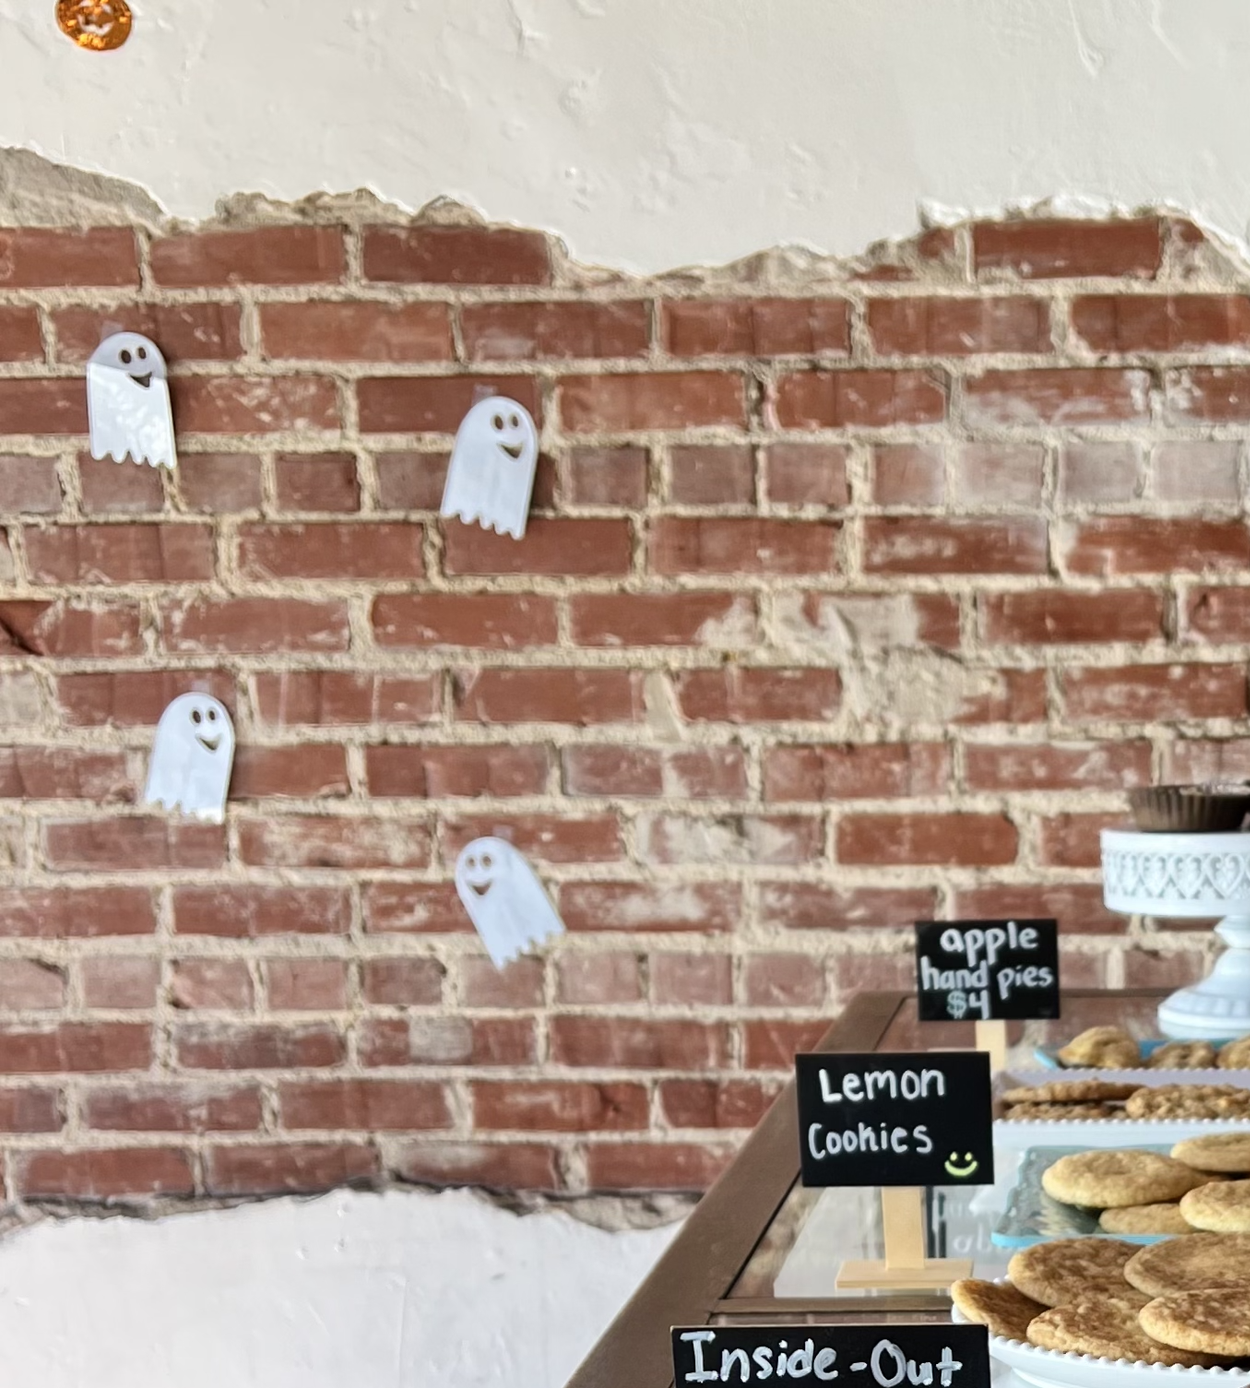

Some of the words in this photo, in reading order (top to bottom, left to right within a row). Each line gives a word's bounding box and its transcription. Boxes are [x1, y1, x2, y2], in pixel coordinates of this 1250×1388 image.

[939, 921, 1038, 966] apple
[921, 956, 990, 990] hand
[997, 964, 1053, 1000] pies
[946, 989, 991, 1020] $4
[819, 1068, 945, 1102] Lemon
[808, 1122, 933, 1160] Cookies
